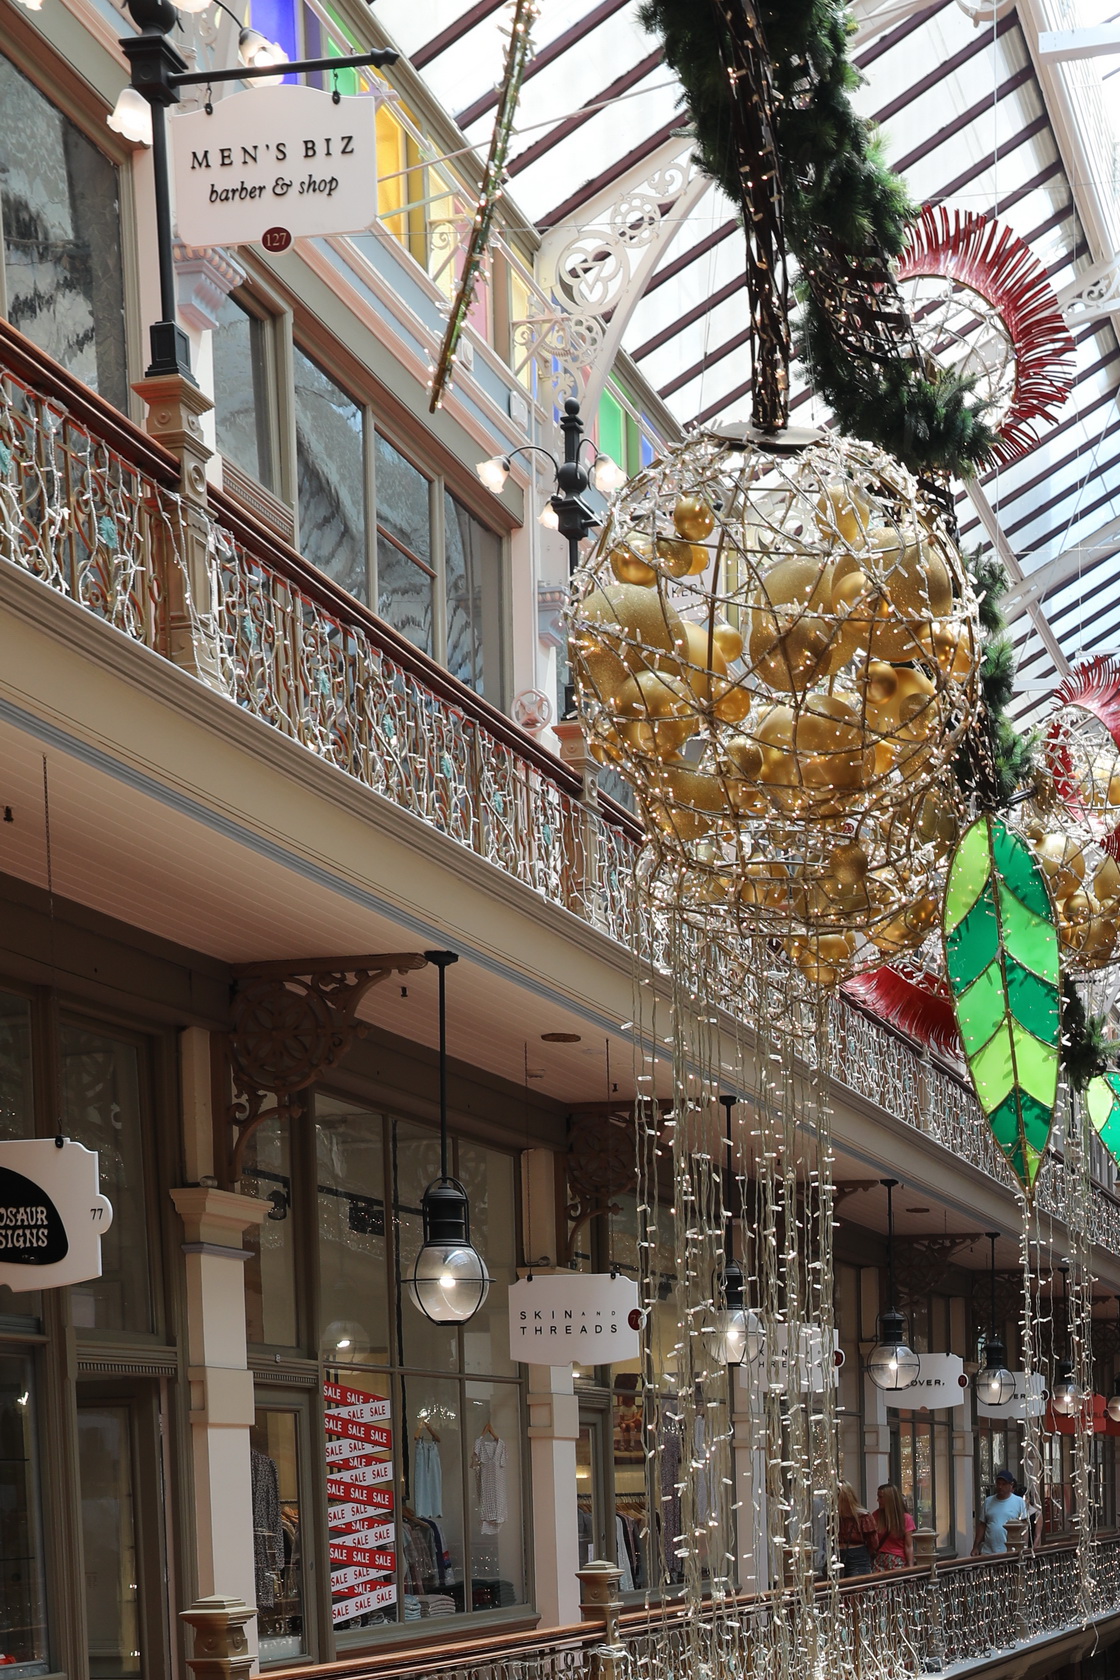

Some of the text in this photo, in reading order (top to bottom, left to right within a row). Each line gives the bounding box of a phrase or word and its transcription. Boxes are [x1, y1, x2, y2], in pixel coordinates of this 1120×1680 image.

[190, 135, 355, 170] MEN'S BIZ
[208, 174, 339, 203] barber & shop
[265, 233, 287, 247] 127
[90, 1208, 104, 1221] 77
[520, 1310, 573, 1320] SKIN
[520, 1324, 618, 1335] THREADS
[324, 1385, 364, 1405] SALE SALE
[370, 1405, 386, 1417] SALE
[324, 1418, 387, 1443] SALE SALE SALE
[326, 1445, 343, 1457] SALE
[372, 1467, 388, 1480] SALE
[327, 1483, 389, 1505] SALE SALE SALE
[328, 1509, 345, 1522] SALE
[374, 1529, 390, 1542] SALE
[329, 1548, 391, 1566] SALE SALE SALE
[331, 1573, 348, 1587] SALE
[332, 1590, 392, 1619] SALE SALE SALE
